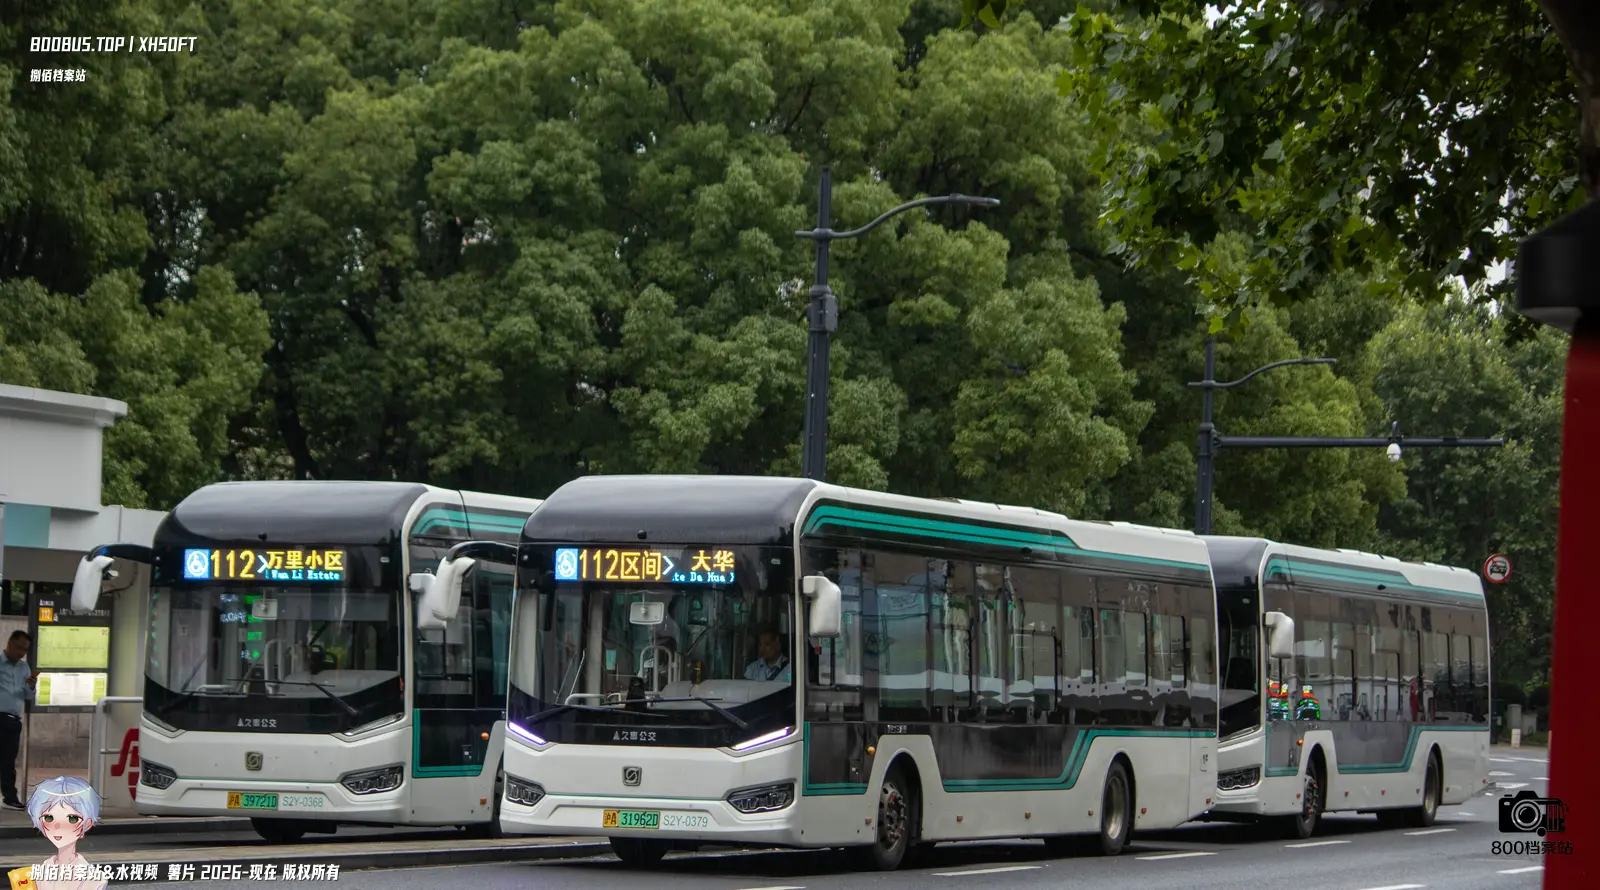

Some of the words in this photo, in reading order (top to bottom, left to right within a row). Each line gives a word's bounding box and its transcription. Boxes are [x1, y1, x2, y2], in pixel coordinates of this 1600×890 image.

[210, 549, 256, 578] 112
[266, 550, 344, 570] 万里小区
[579, 549, 662, 581] 112区间
[691, 550, 734, 572] 大华
[291, 569, 304, 580] Li
[307, 569, 340, 580] Estate
[672, 572, 686, 582] te
[690, 572, 703, 582] Da
[707, 572, 726, 582] Hua
[243, 794, 277, 808] 39721D
[282, 796, 324, 808] S2Y-0368
[621, 812, 658, 826] 31962D
[663, 815, 708, 828] S2Y-0379
